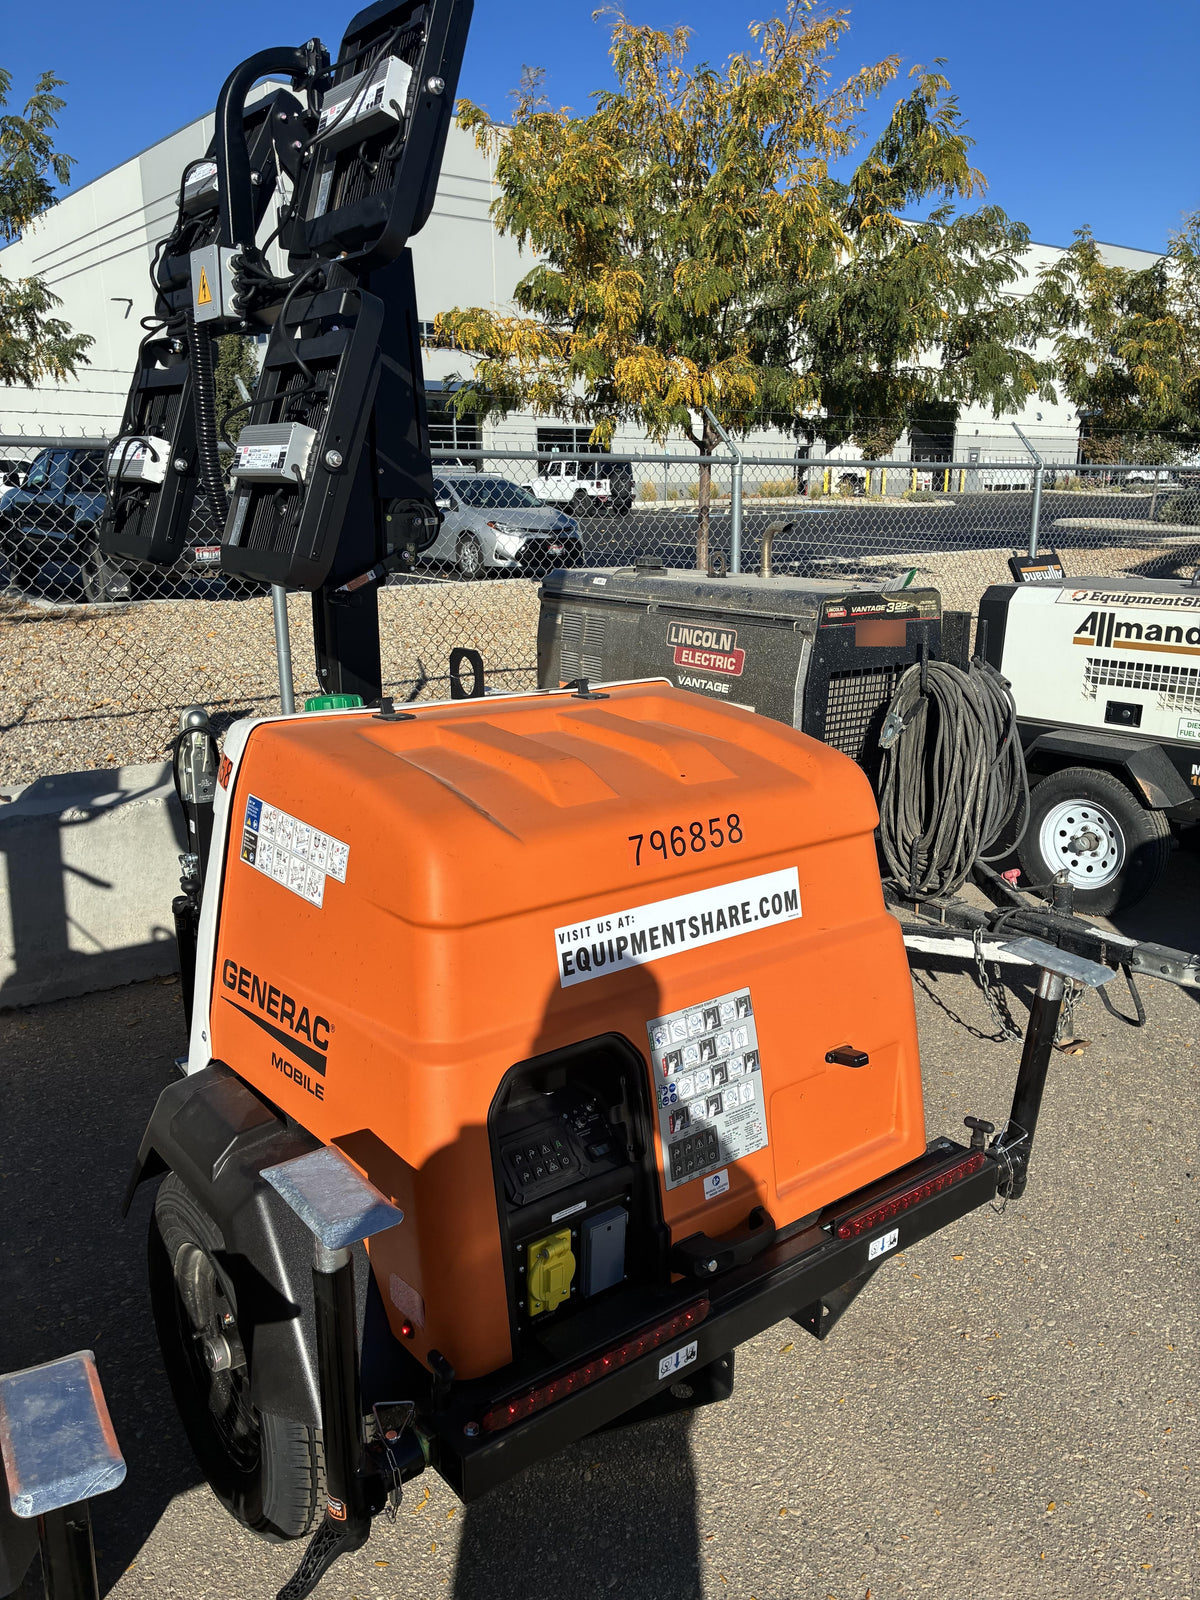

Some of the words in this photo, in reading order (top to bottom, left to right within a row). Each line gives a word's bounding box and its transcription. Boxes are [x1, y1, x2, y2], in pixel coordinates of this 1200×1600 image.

[852, 604, 886, 613] VANTAGE
[886, 601, 908, 613] 322
[670, 626, 732, 651] LINCOLN
[682, 650, 736, 670] ELECTRIC
[678, 676, 730, 694] VANTAGE
[1180, 730, 1196, 738] FUEL
[628, 813, 743, 866] 796858
[558, 926, 591, 945] VISIT
[597, 921, 612, 934] US
[618, 915, 634, 928] AT:
[561, 888, 799, 977] EQUIPMENTSHARE.COM
[271, 1052, 324, 1102] MOBILE
